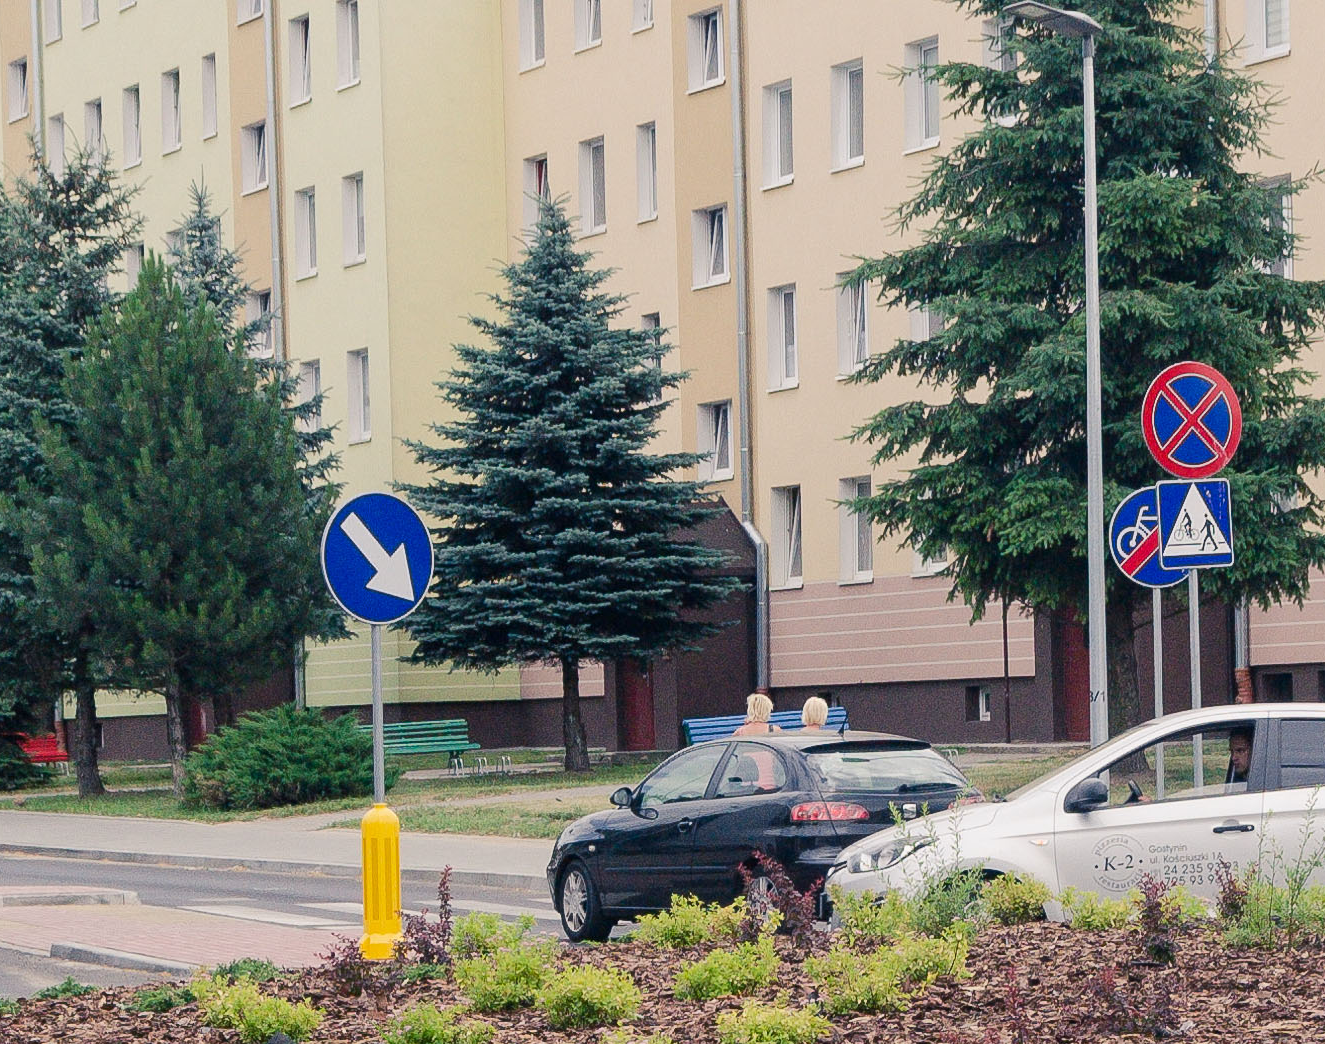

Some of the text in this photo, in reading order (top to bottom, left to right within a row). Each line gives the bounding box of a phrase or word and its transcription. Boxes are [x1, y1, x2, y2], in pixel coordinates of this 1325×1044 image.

[1095, 837, 1128, 856] pizzeria
[1148, 843, 1187, 854] Gostynin
[1104, 854, 1134, 871] K-2
[1149, 851, 1223, 864] ul. Kościuszki 1A
[1164, 864, 1177, 875] 24
[1182, 862, 1203, 874] 235
[1207, 862, 1221, 872] 93
[1190, 874, 1203, 885] 93
